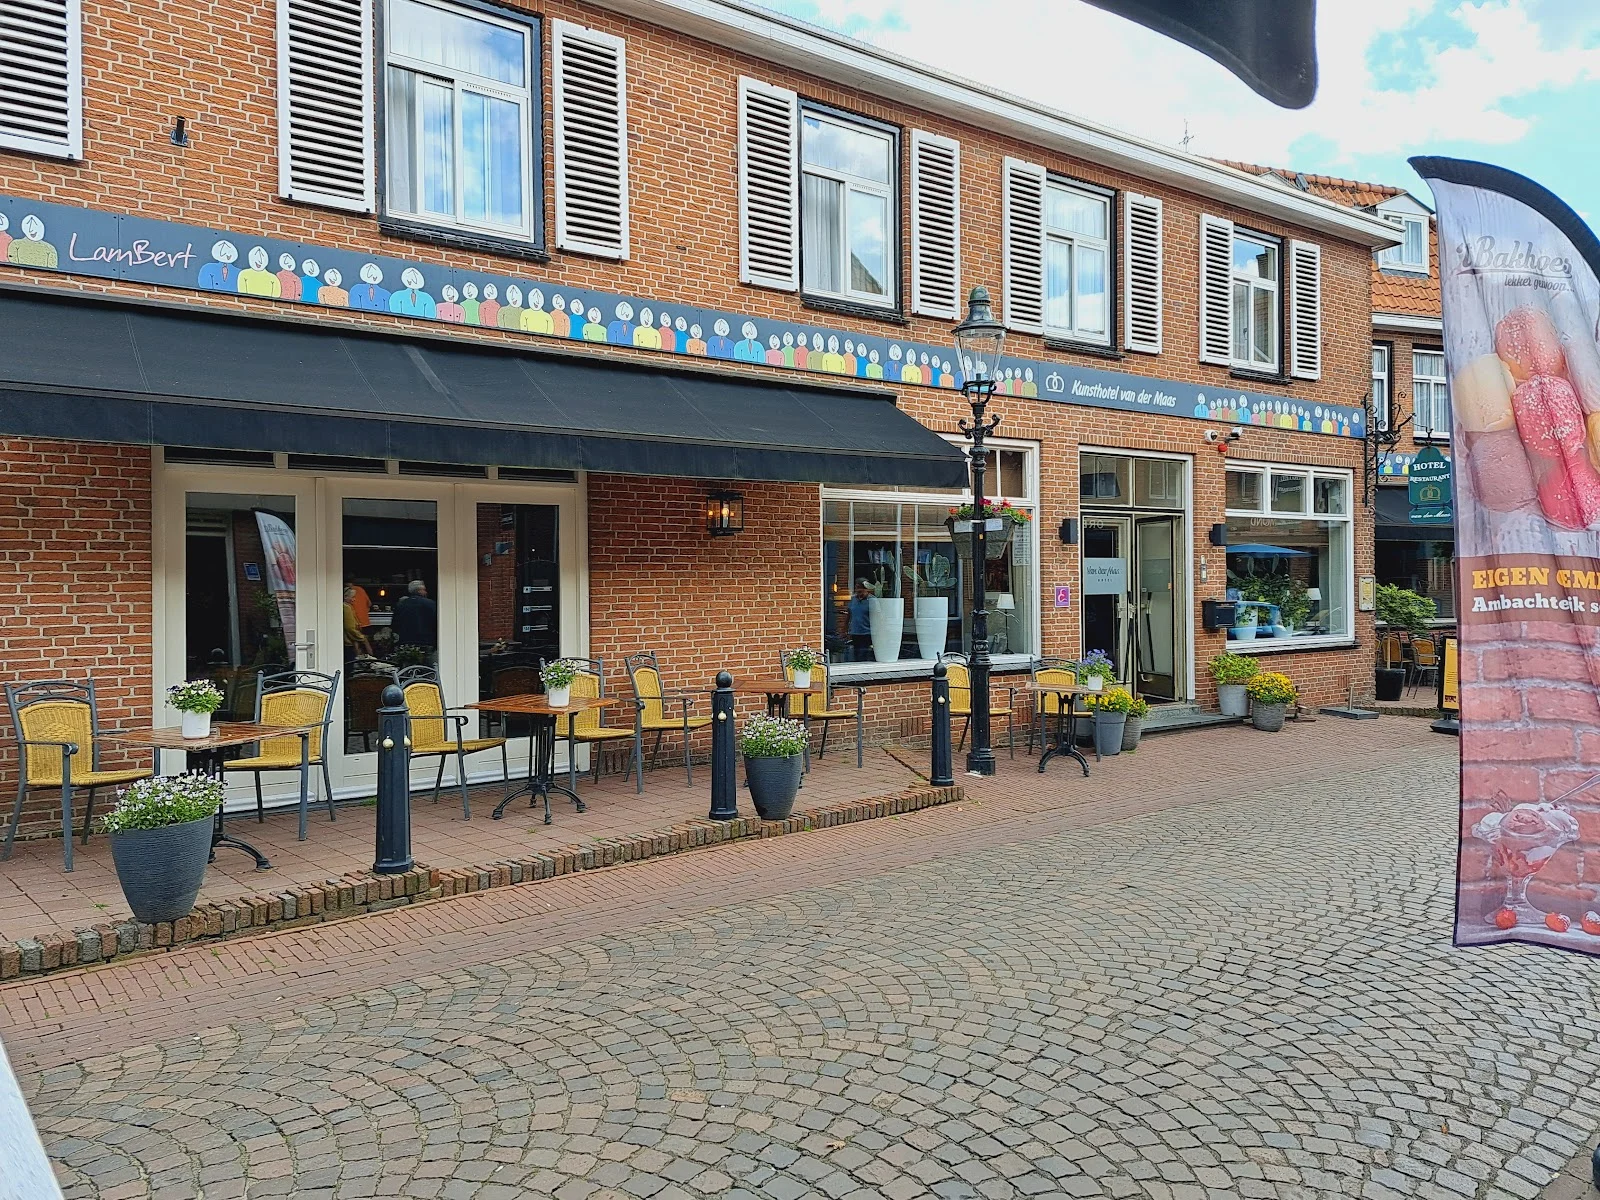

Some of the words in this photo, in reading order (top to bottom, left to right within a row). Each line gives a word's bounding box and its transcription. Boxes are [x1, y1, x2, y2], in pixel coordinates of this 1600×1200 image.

[69, 232, 197, 269] LamBert
[1474, 235, 1573, 275] Bakhoes
[1504, 275, 1532, 287] lekker
[1071, 379, 1120, 400] Kunsthotel
[1120, 389, 1136, 402] van
[1137, 389, 1153, 405] der
[1153, 391, 1177, 408] Maas
[1413, 461, 1447, 472] HOTEL
[1409, 473, 1451, 484] RESTAURANT
[1472, 567, 1550, 589] EIGEN
